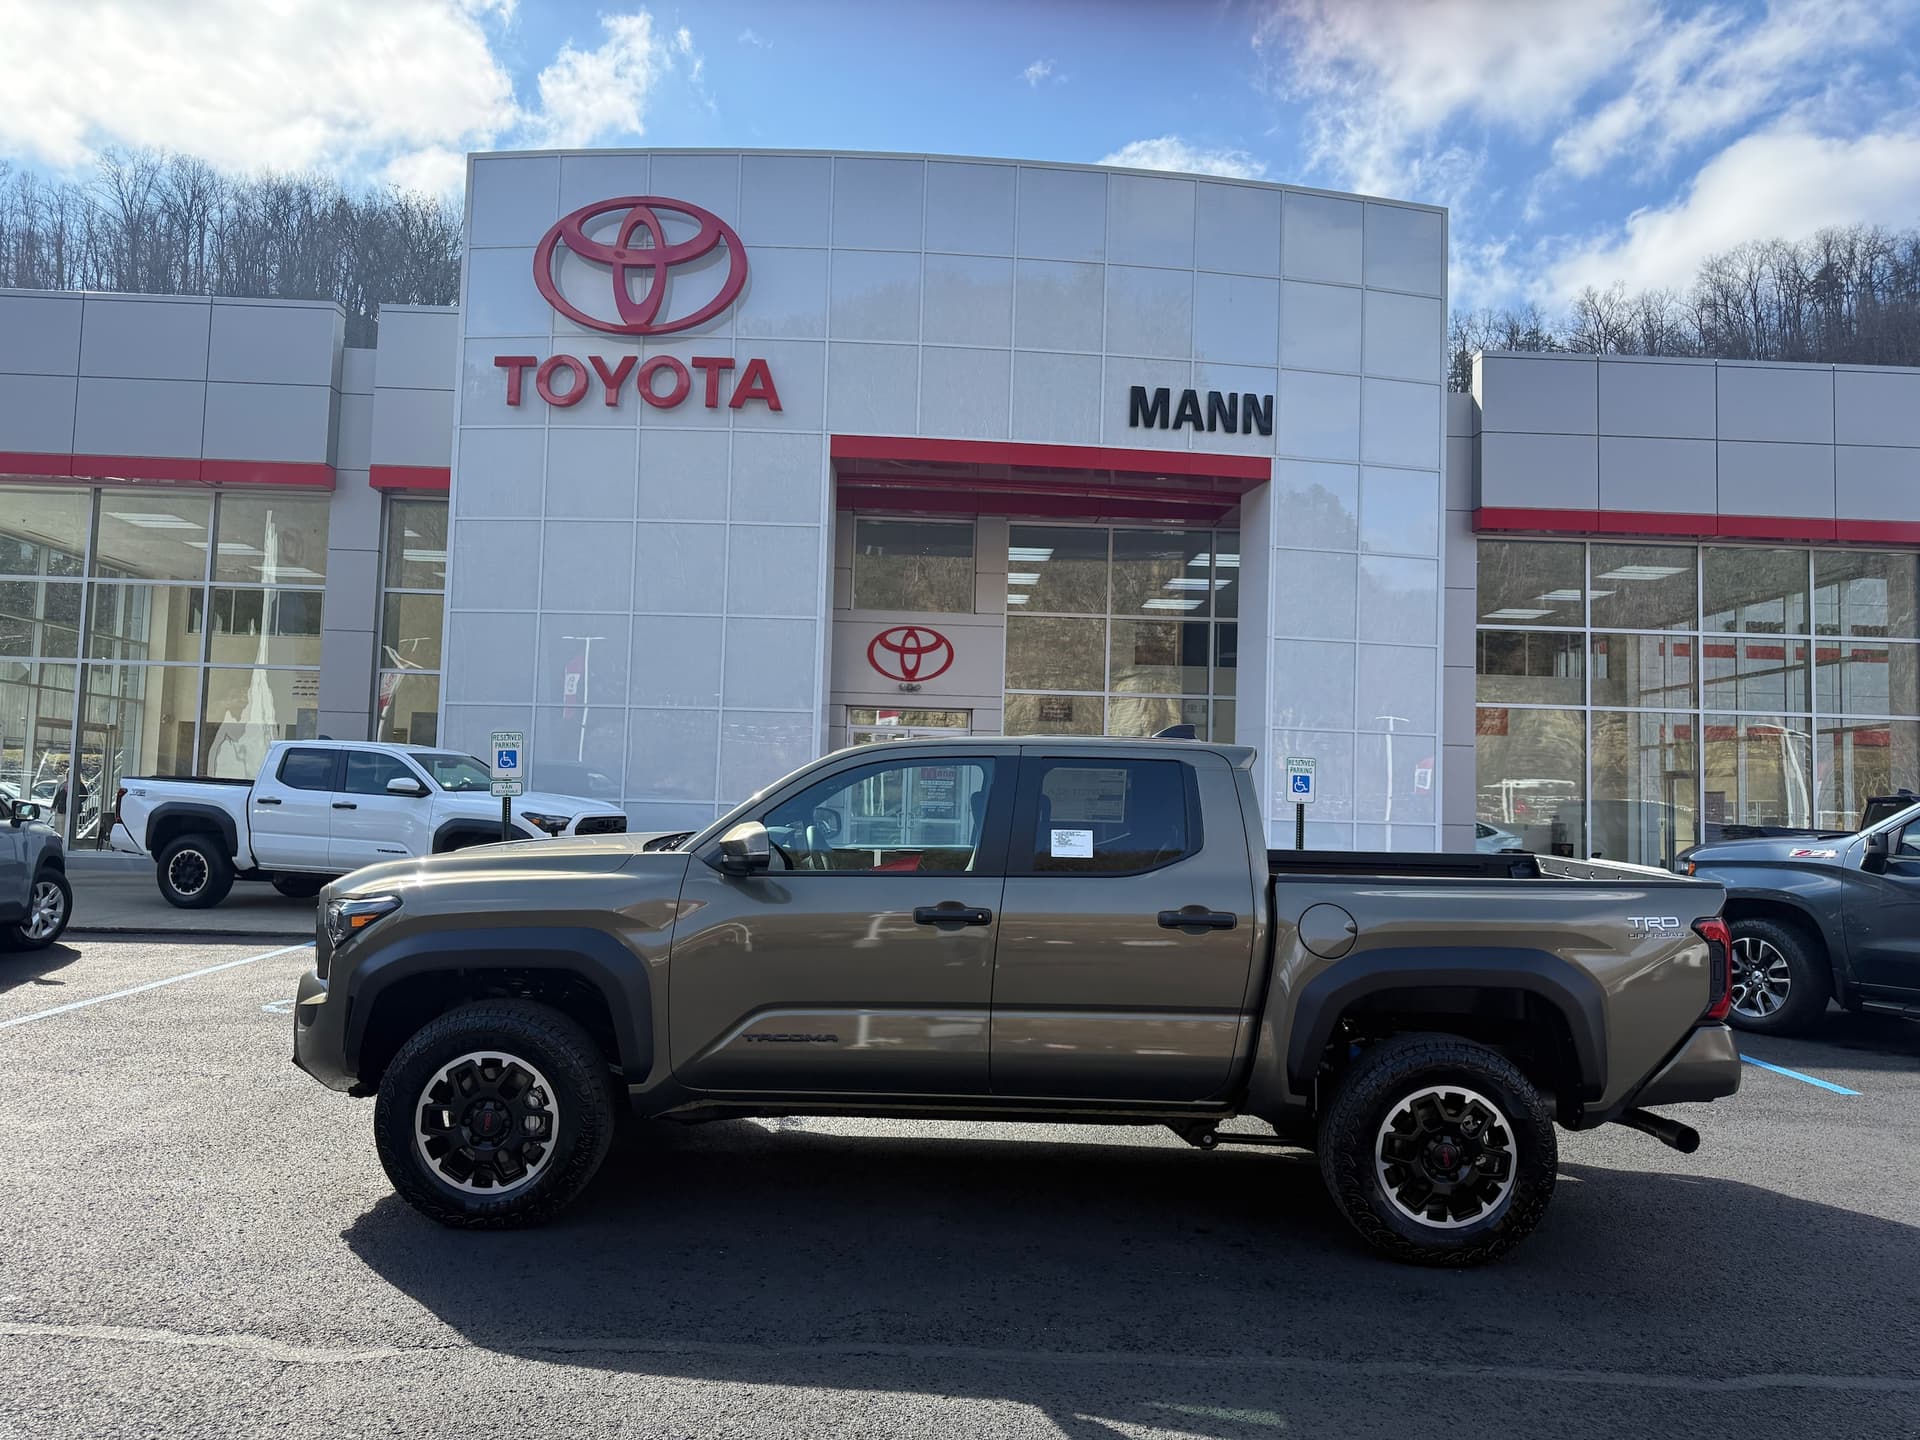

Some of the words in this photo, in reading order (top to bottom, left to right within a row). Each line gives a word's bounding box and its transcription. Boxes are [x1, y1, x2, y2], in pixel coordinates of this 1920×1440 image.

[494, 354, 783, 412] TOYOTA
[1129, 385, 1274, 436] MANN
[1288, 759, 1315, 767] RESERVED
[1289, 766, 1312, 774] PARKING
[1627, 916, 1680, 931] TRD
[742, 1033, 839, 1042] TACOMA
